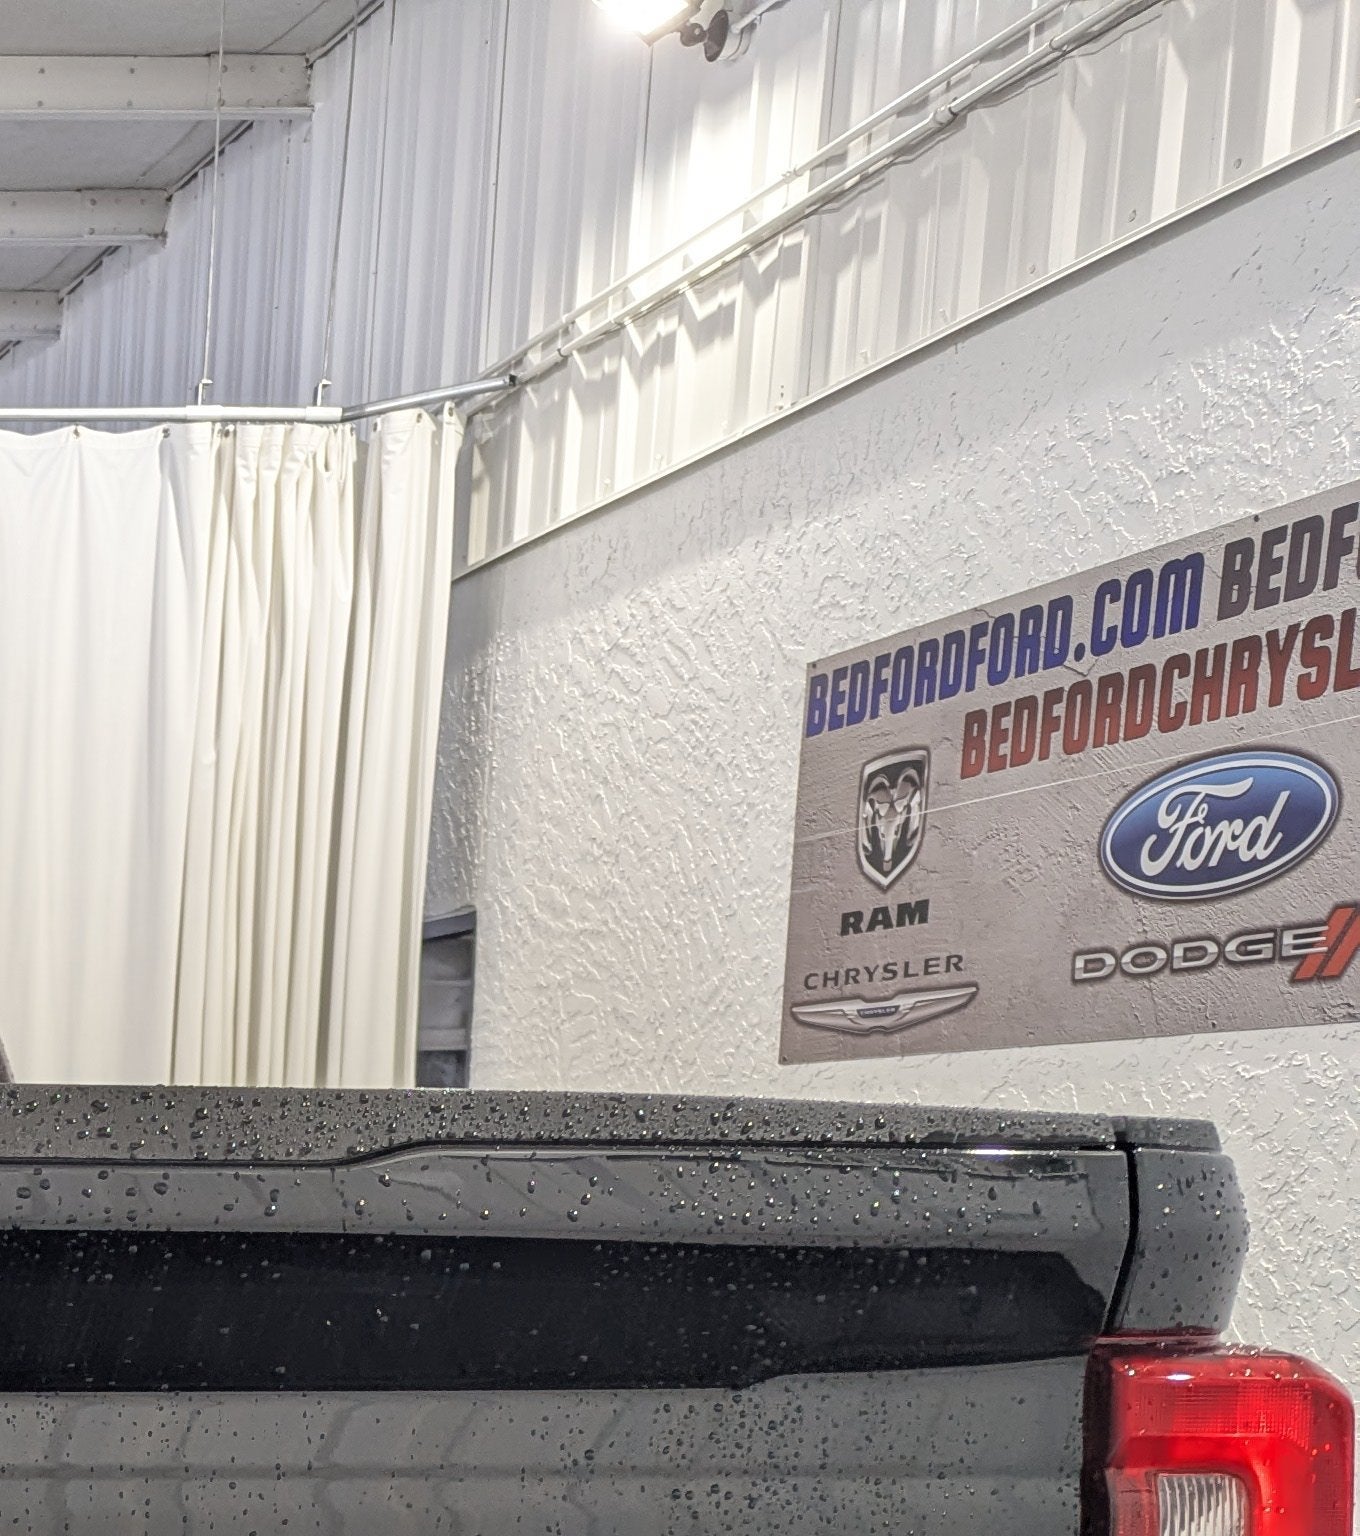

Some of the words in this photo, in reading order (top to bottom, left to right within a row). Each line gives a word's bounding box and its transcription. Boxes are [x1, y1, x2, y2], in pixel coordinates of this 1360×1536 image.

[806, 552, 1204, 738] BEDFORDFORD.COM
[1217, 502, 1360, 621] BEDF
[1140, 776, 1290, 873] Ford
[840, 899, 930, 936] RAM
[803, 954, 965, 990] CHRYSLER
[1073, 925, 1330, 982] DODGE
